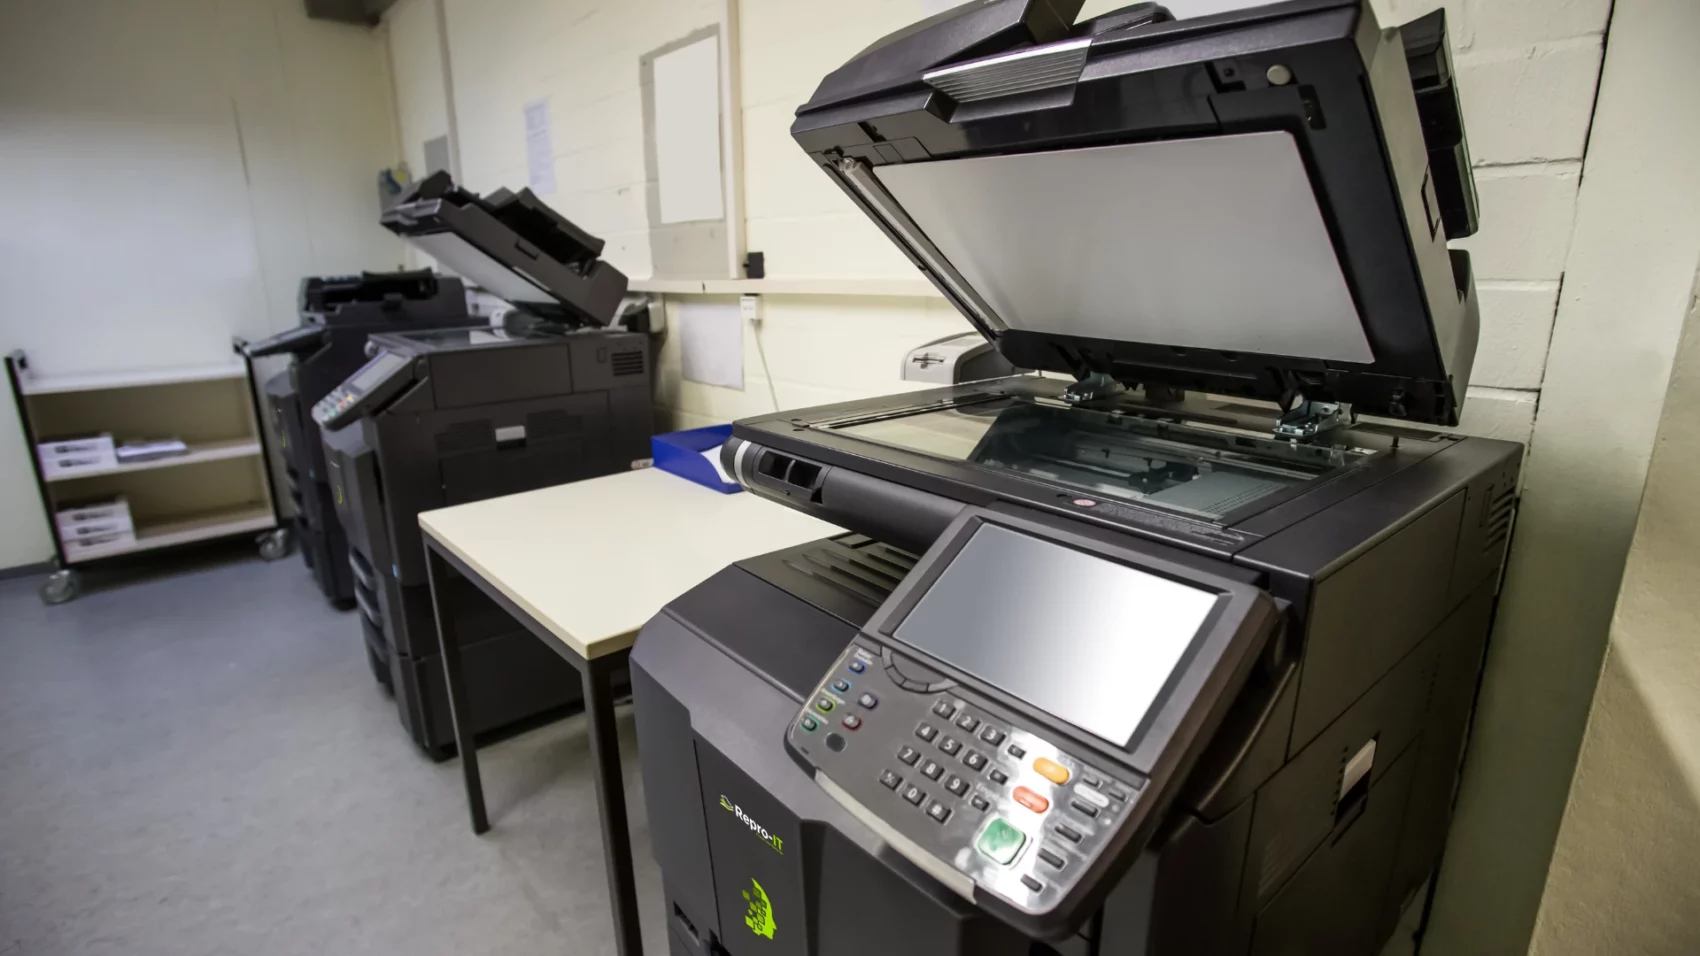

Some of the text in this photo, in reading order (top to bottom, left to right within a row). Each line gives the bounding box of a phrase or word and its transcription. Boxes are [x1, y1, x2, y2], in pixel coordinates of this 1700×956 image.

[939, 703, 997, 740] 1 2 3
[921, 726, 978, 765] 4 5 6
[903, 748, 960, 790] 7 8 9
[908, 787, 917, 799] 0
[735, 804, 784, 851] Repro-IT
